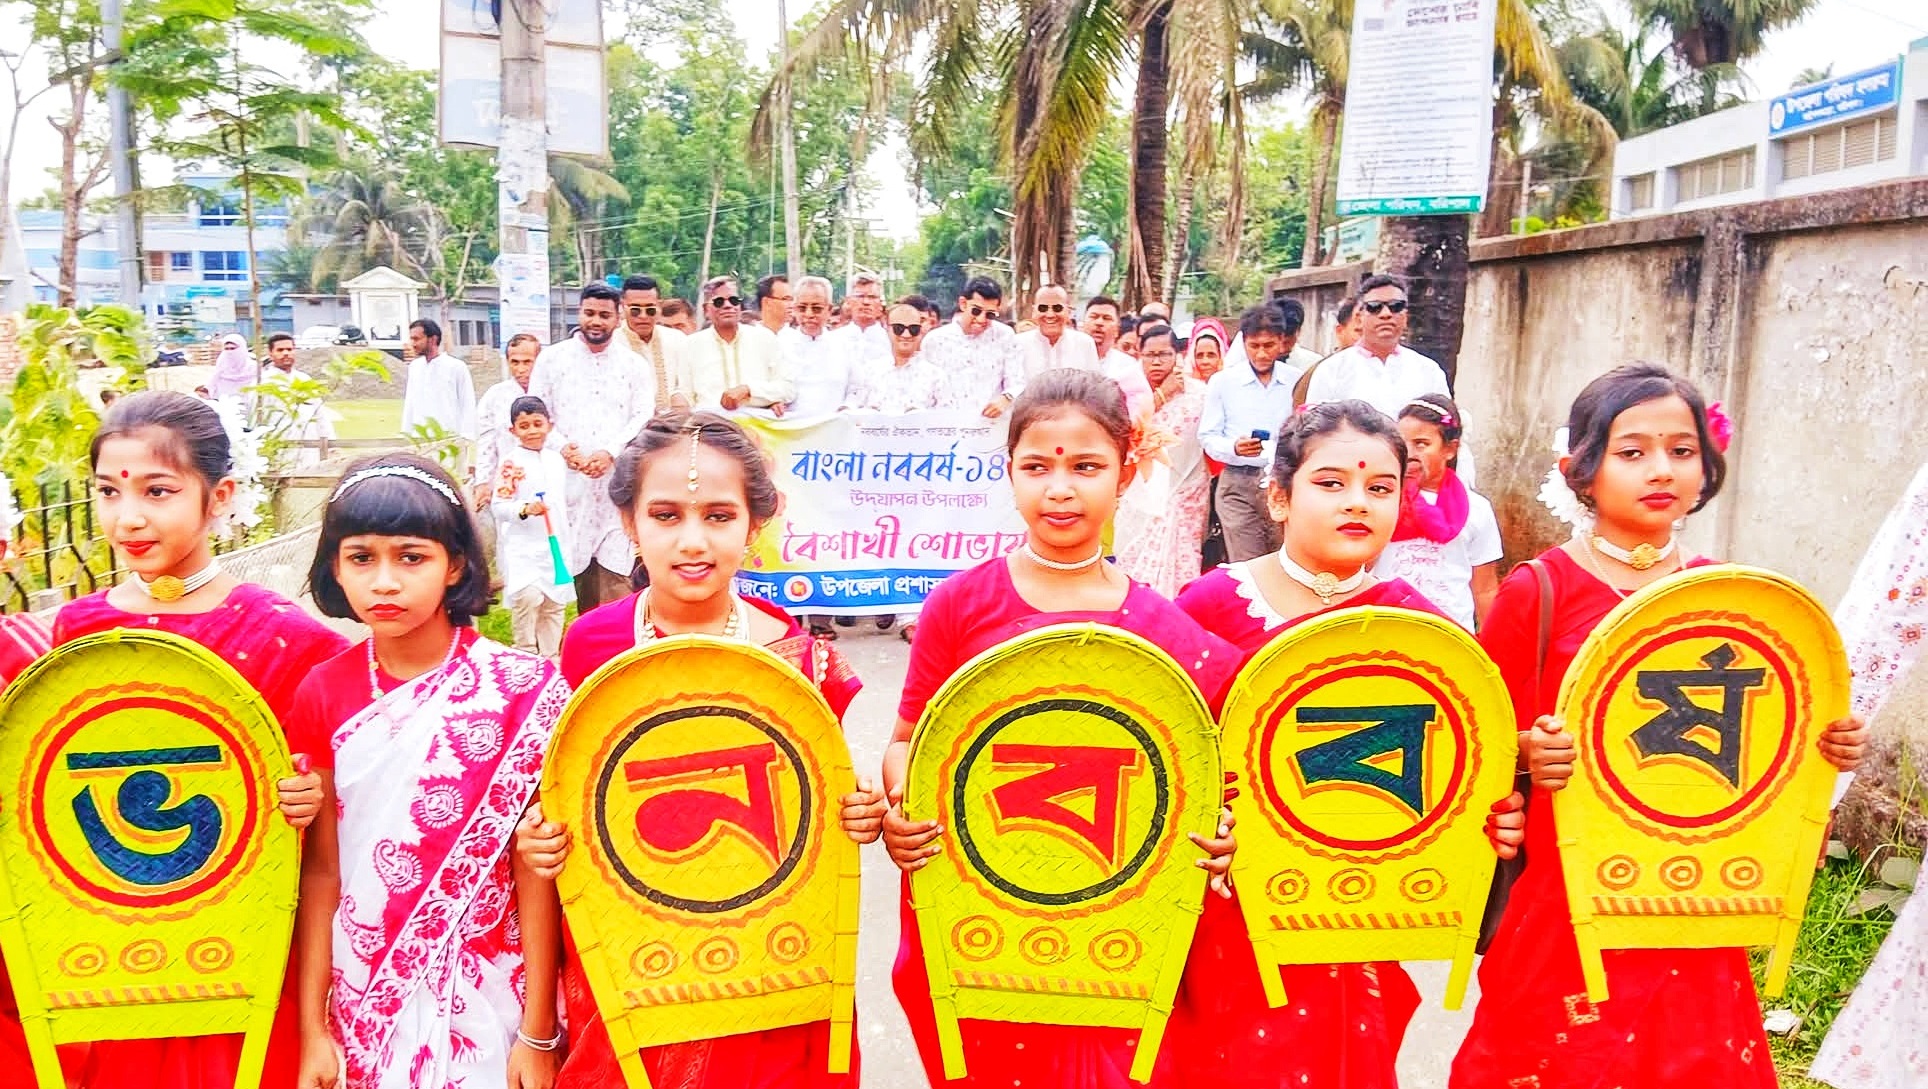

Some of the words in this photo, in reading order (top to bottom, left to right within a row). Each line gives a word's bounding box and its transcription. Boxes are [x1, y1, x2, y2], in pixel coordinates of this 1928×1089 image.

[791, 450, 867, 482] বাংলা
[872, 440, 1005, 482] নববর্ষ-১৪
[783, 515, 902, 562] বৈশাখী
[908, 531, 1028, 560] শোভায
[819, 575, 890, 597] উপজেলা
[66, 745, 224, 886] ভ
[624, 742, 783, 860] ন
[987, 743, 1137, 866] ব
[1295, 704, 1436, 819] ব
